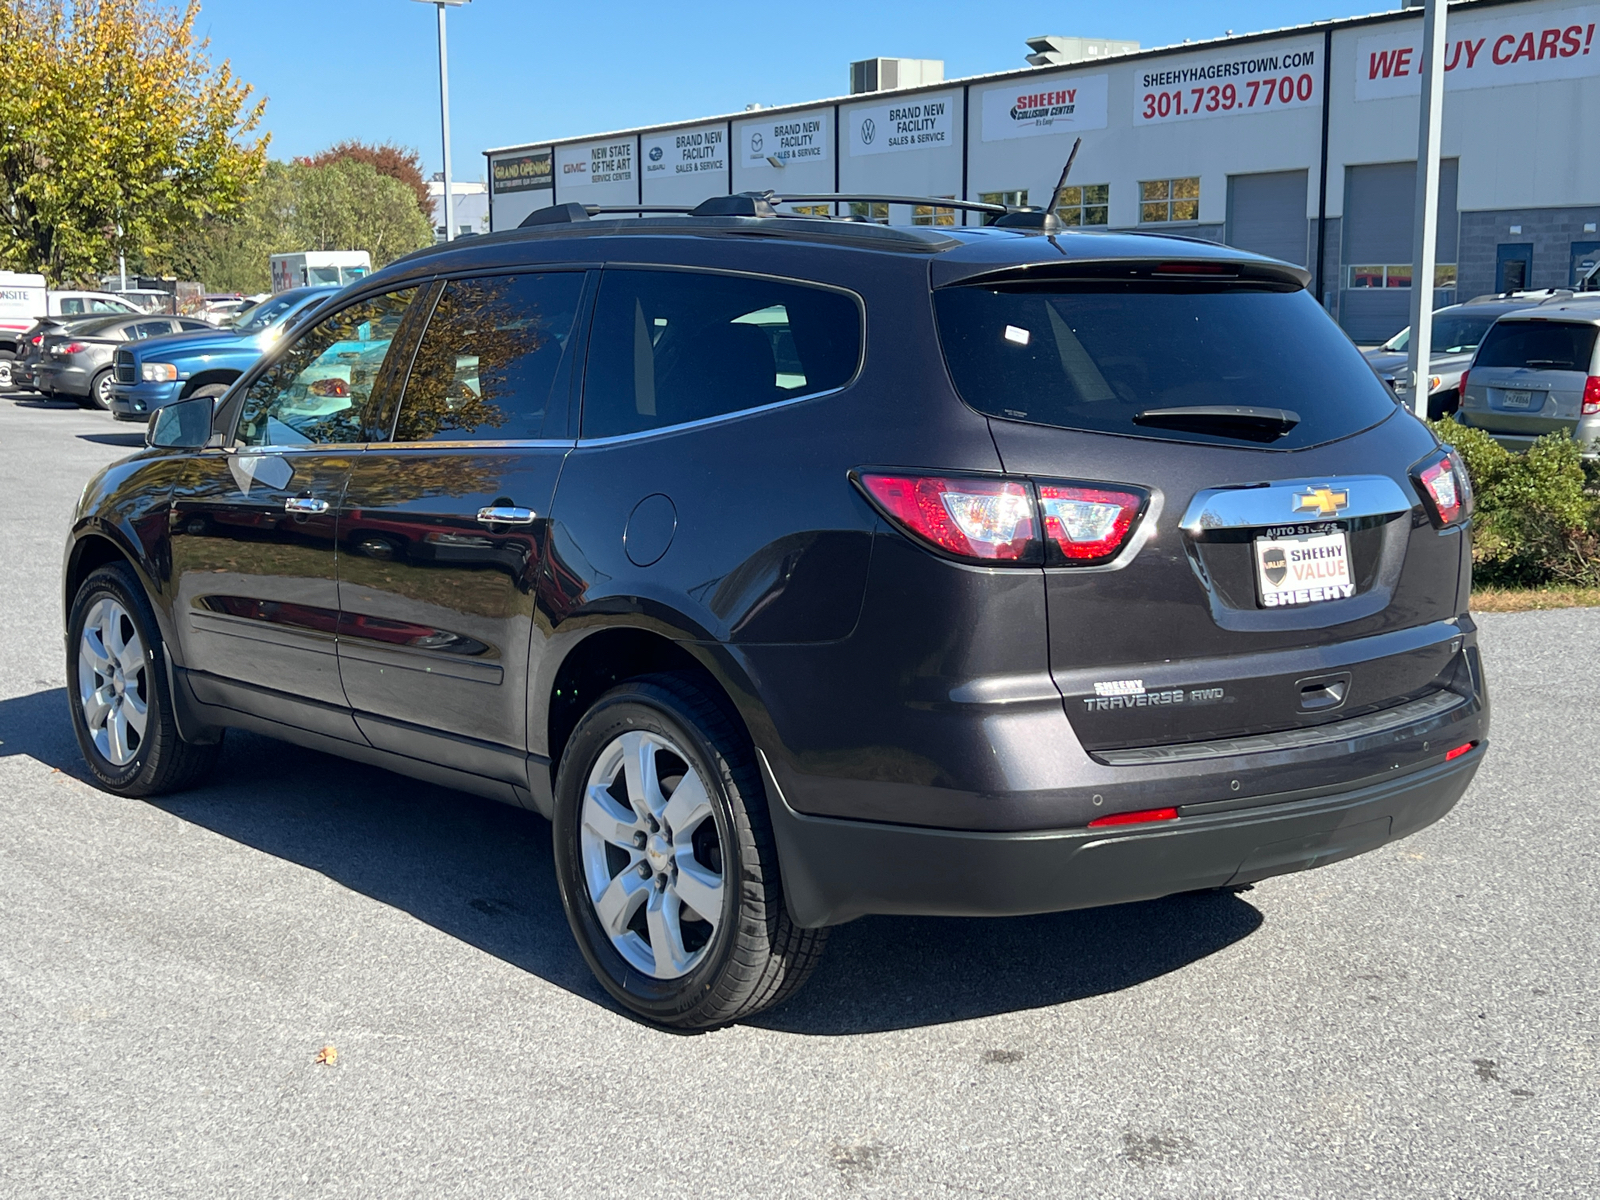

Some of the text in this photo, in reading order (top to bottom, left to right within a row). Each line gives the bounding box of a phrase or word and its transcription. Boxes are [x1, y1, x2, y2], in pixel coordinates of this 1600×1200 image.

[1368, 23, 1596, 80] WE UY CARS!
[1143, 51, 1315, 88] SHEEHYHAGERSTOWN.COM
[1016, 88, 1077, 110] SHEEHY
[1142, 73, 1313, 119] 301.739.7700
[889, 102, 945, 121] BRAND NEW
[1016, 104, 1075, 121] COLLISION CENTER
[774, 121, 820, 137] BRAND NEW
[897, 117, 936, 133] FACILITY
[676, 131, 723, 148] BRAND NEW
[780, 134, 813, 148] FACILITY
[888, 132, 945, 147] SALES & SERVICE
[591, 144, 631, 160] NEW STATE
[682, 145, 715, 160] FACILITY
[791, 149, 796, 158] &
[797, 147, 821, 157] SERVICE
[495, 160, 551, 179] GRAND OPENING
[563, 162, 587, 174] GMC
[591, 158, 631, 173] OF THE ART
[675, 160, 723, 174] SALES & SERVICE
[591, 171, 631, 183] SERVICE CENTER
[1266, 523, 1338, 537] AUTO STES
[1291, 544, 1343, 562] SHEEHY
[1292, 559, 1346, 581] VALUE
[1263, 583, 1355, 607] SHEEHY
[1093, 679, 1143, 691] SHEEHY
[1083, 687, 1224, 712] TRAVERSE AWD
